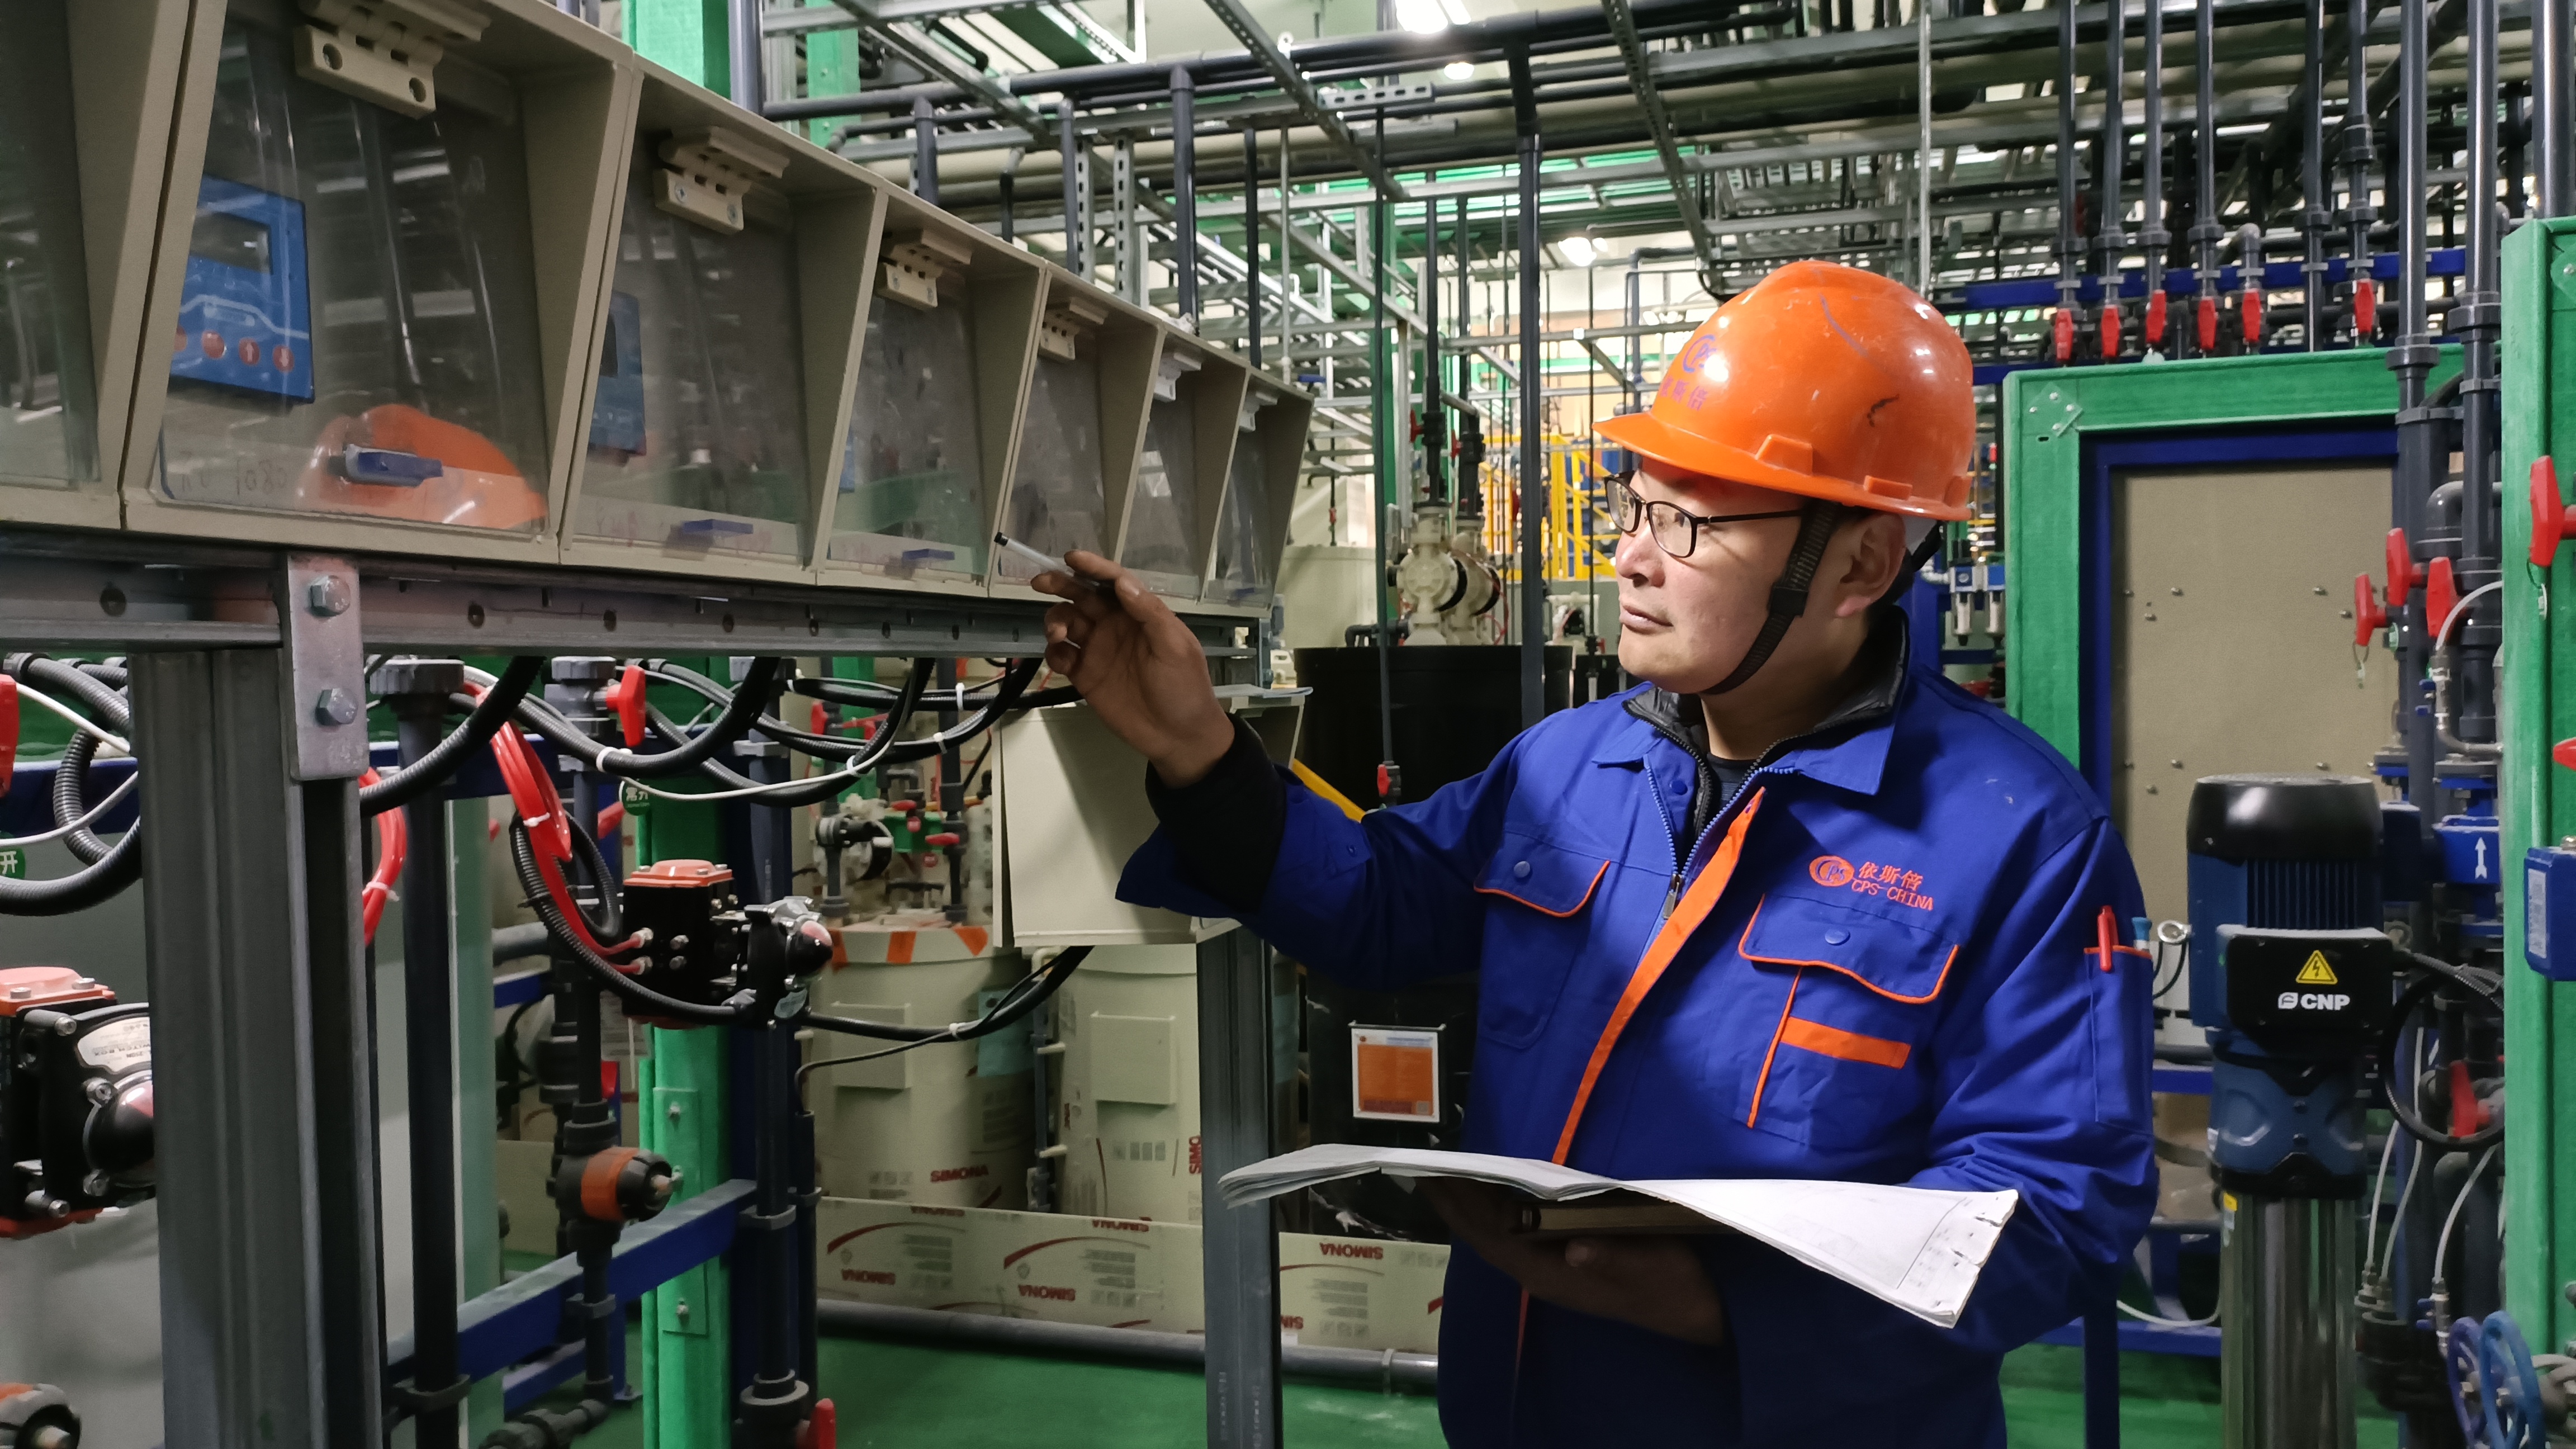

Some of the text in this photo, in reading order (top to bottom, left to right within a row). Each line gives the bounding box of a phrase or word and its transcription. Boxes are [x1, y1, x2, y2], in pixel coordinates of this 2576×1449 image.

[1858, 861, 1924, 891] 依斯倍
[2300, 993, 2350, 1011] CNP
[1188, 1135, 1202, 1175] SIMO
[930, 1165, 988, 1182] SIMONA
[1320, 1242, 1384, 1260] SIMONA
[1018, 1284, 1076, 1301] SIMONA
